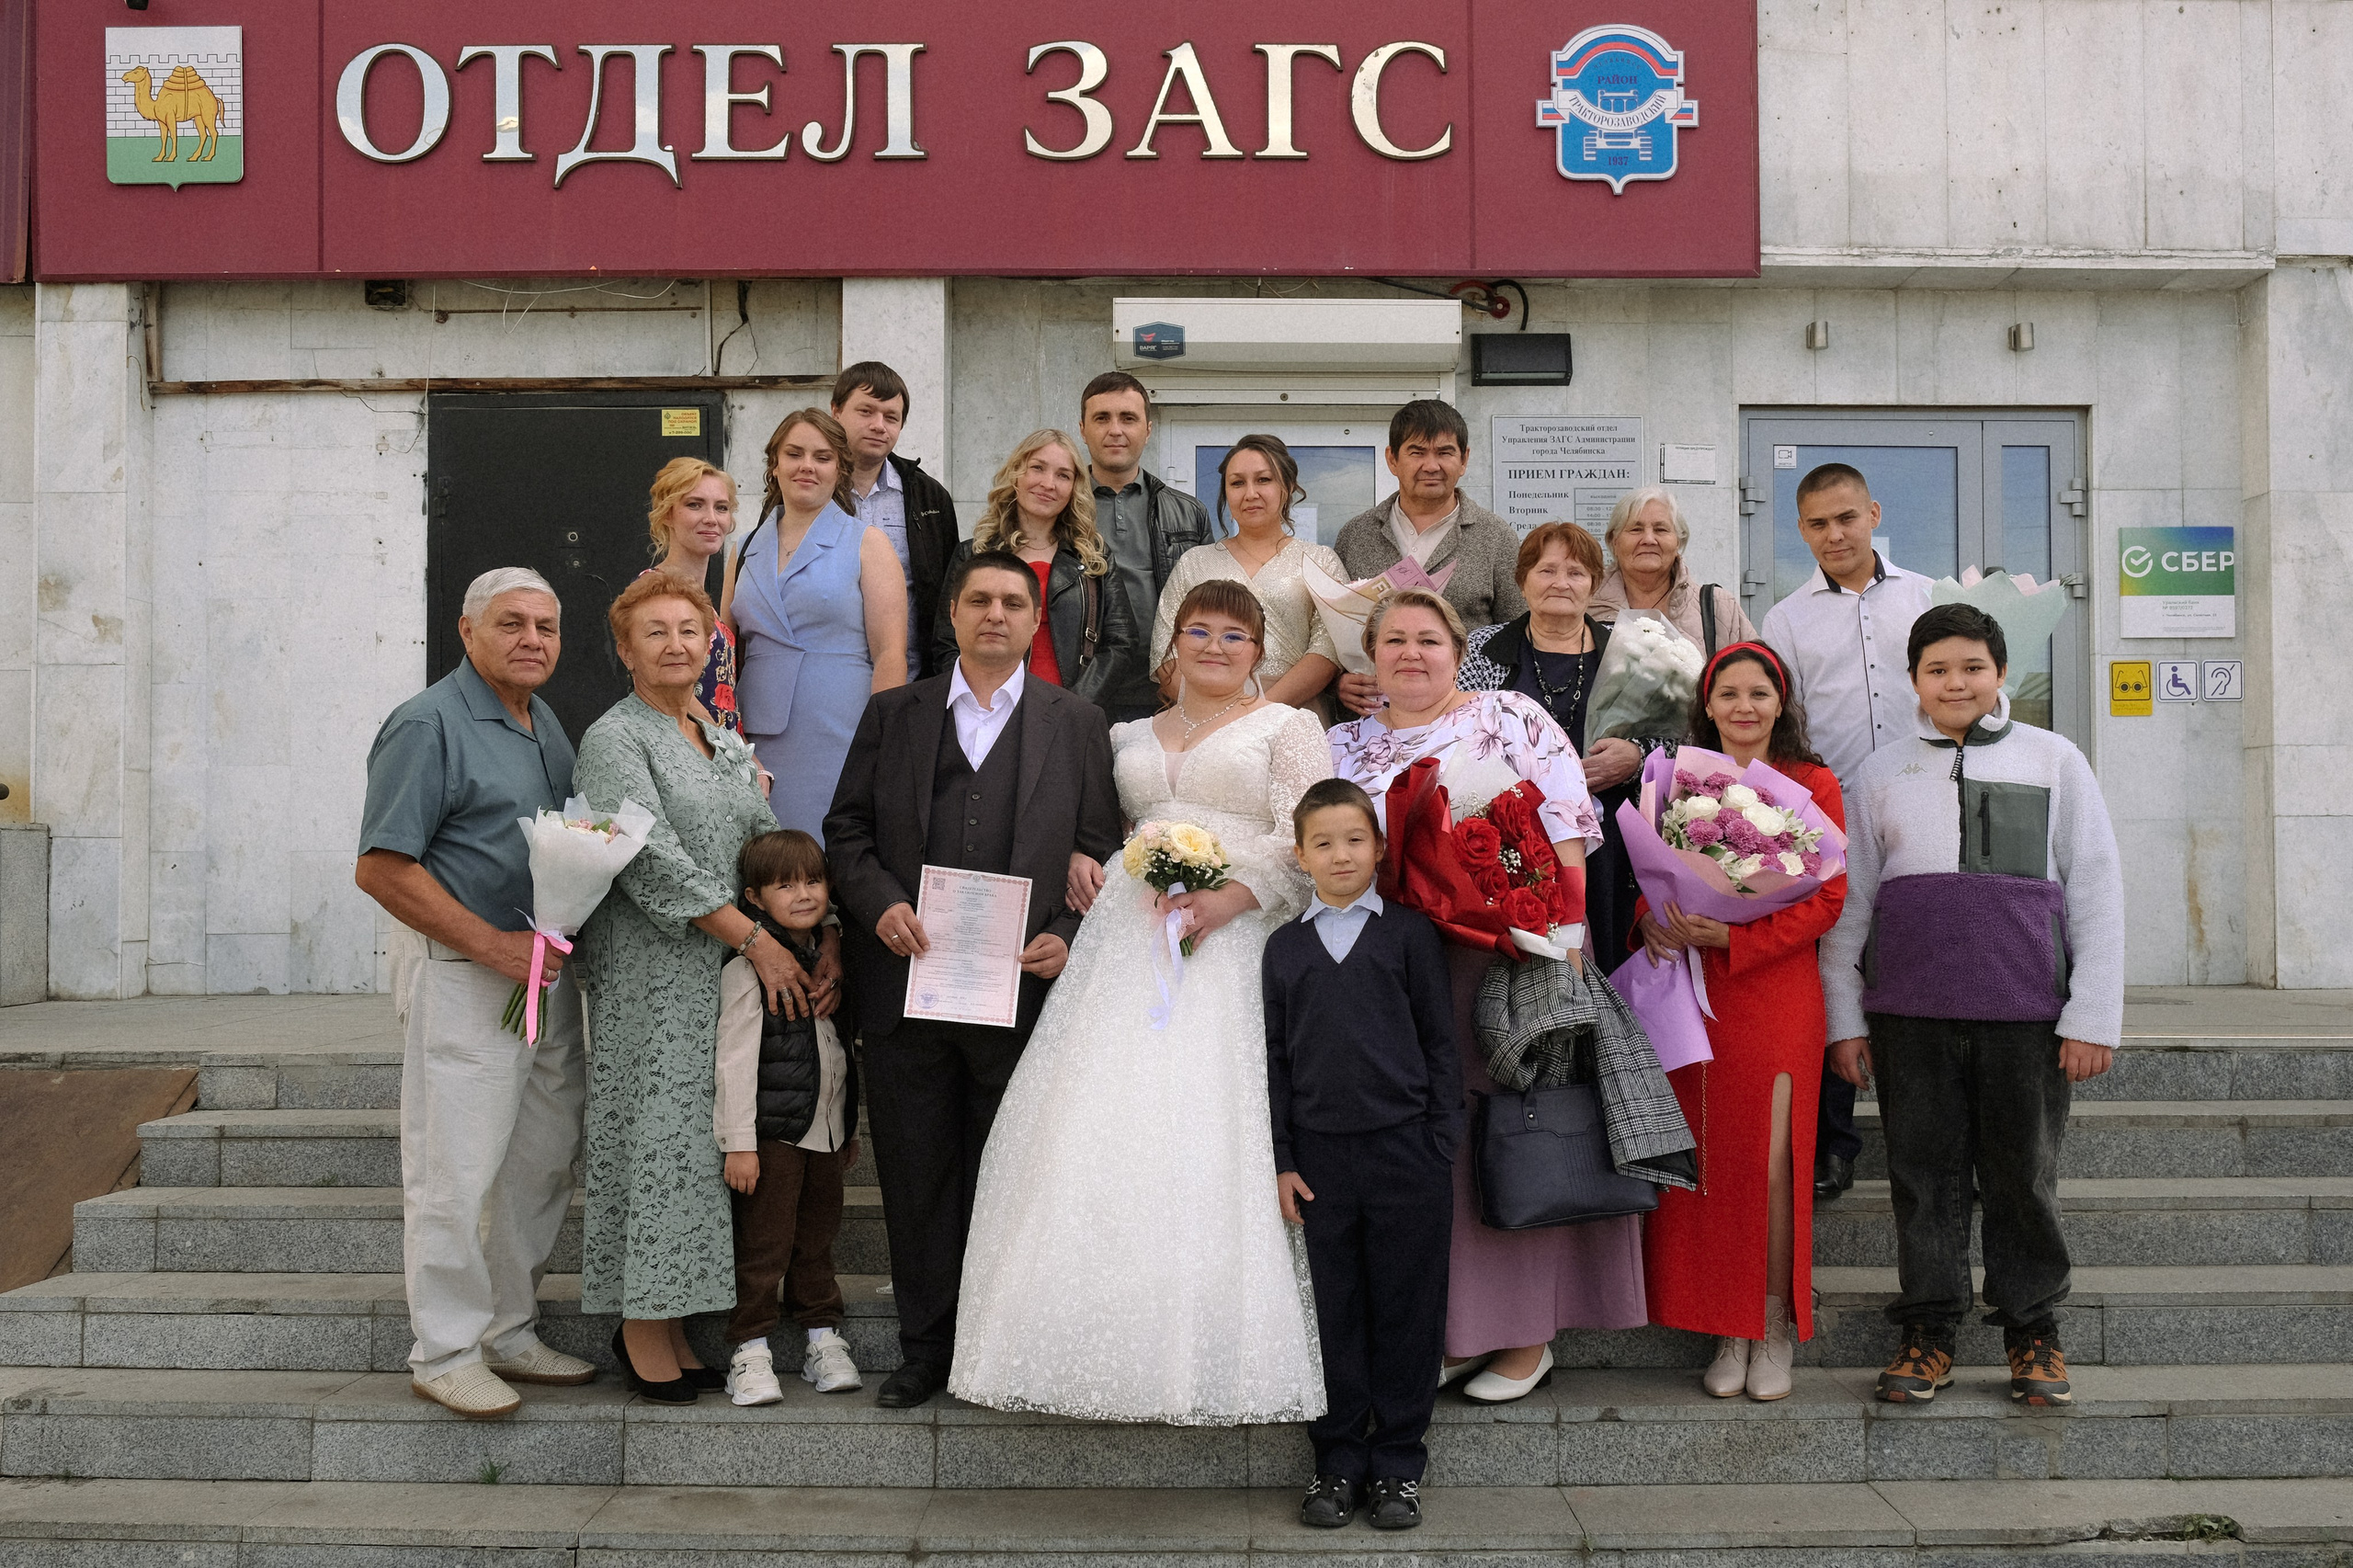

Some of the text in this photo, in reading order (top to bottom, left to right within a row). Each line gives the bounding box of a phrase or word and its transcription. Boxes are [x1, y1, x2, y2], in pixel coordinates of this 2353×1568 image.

[1597, 74, 1638, 85] РАЙОН
[335, 40, 1454, 189] ОТДЕЛ ЗАГС
[1569, 93, 1666, 127] ТРАКТОРОЗАВОДСКИЙ
[1608, 156, 1629, 165] 1937
[1519, 424, 1595, 433] Тракторозаводский
[1502, 436, 1548, 445] Управления
[1575, 435, 1636, 445] Администрации
[1532, 447, 1606, 457] города Челябинска
[1508, 469, 1631, 480] ПРИЕМ ГРАЖДАН:
[1508, 491, 1570, 499] Понедельник
[1508, 506, 1549, 516] Вторник
[1509, 521, 1537, 531] Среда
[2161, 551, 2234, 572] СБЕР
